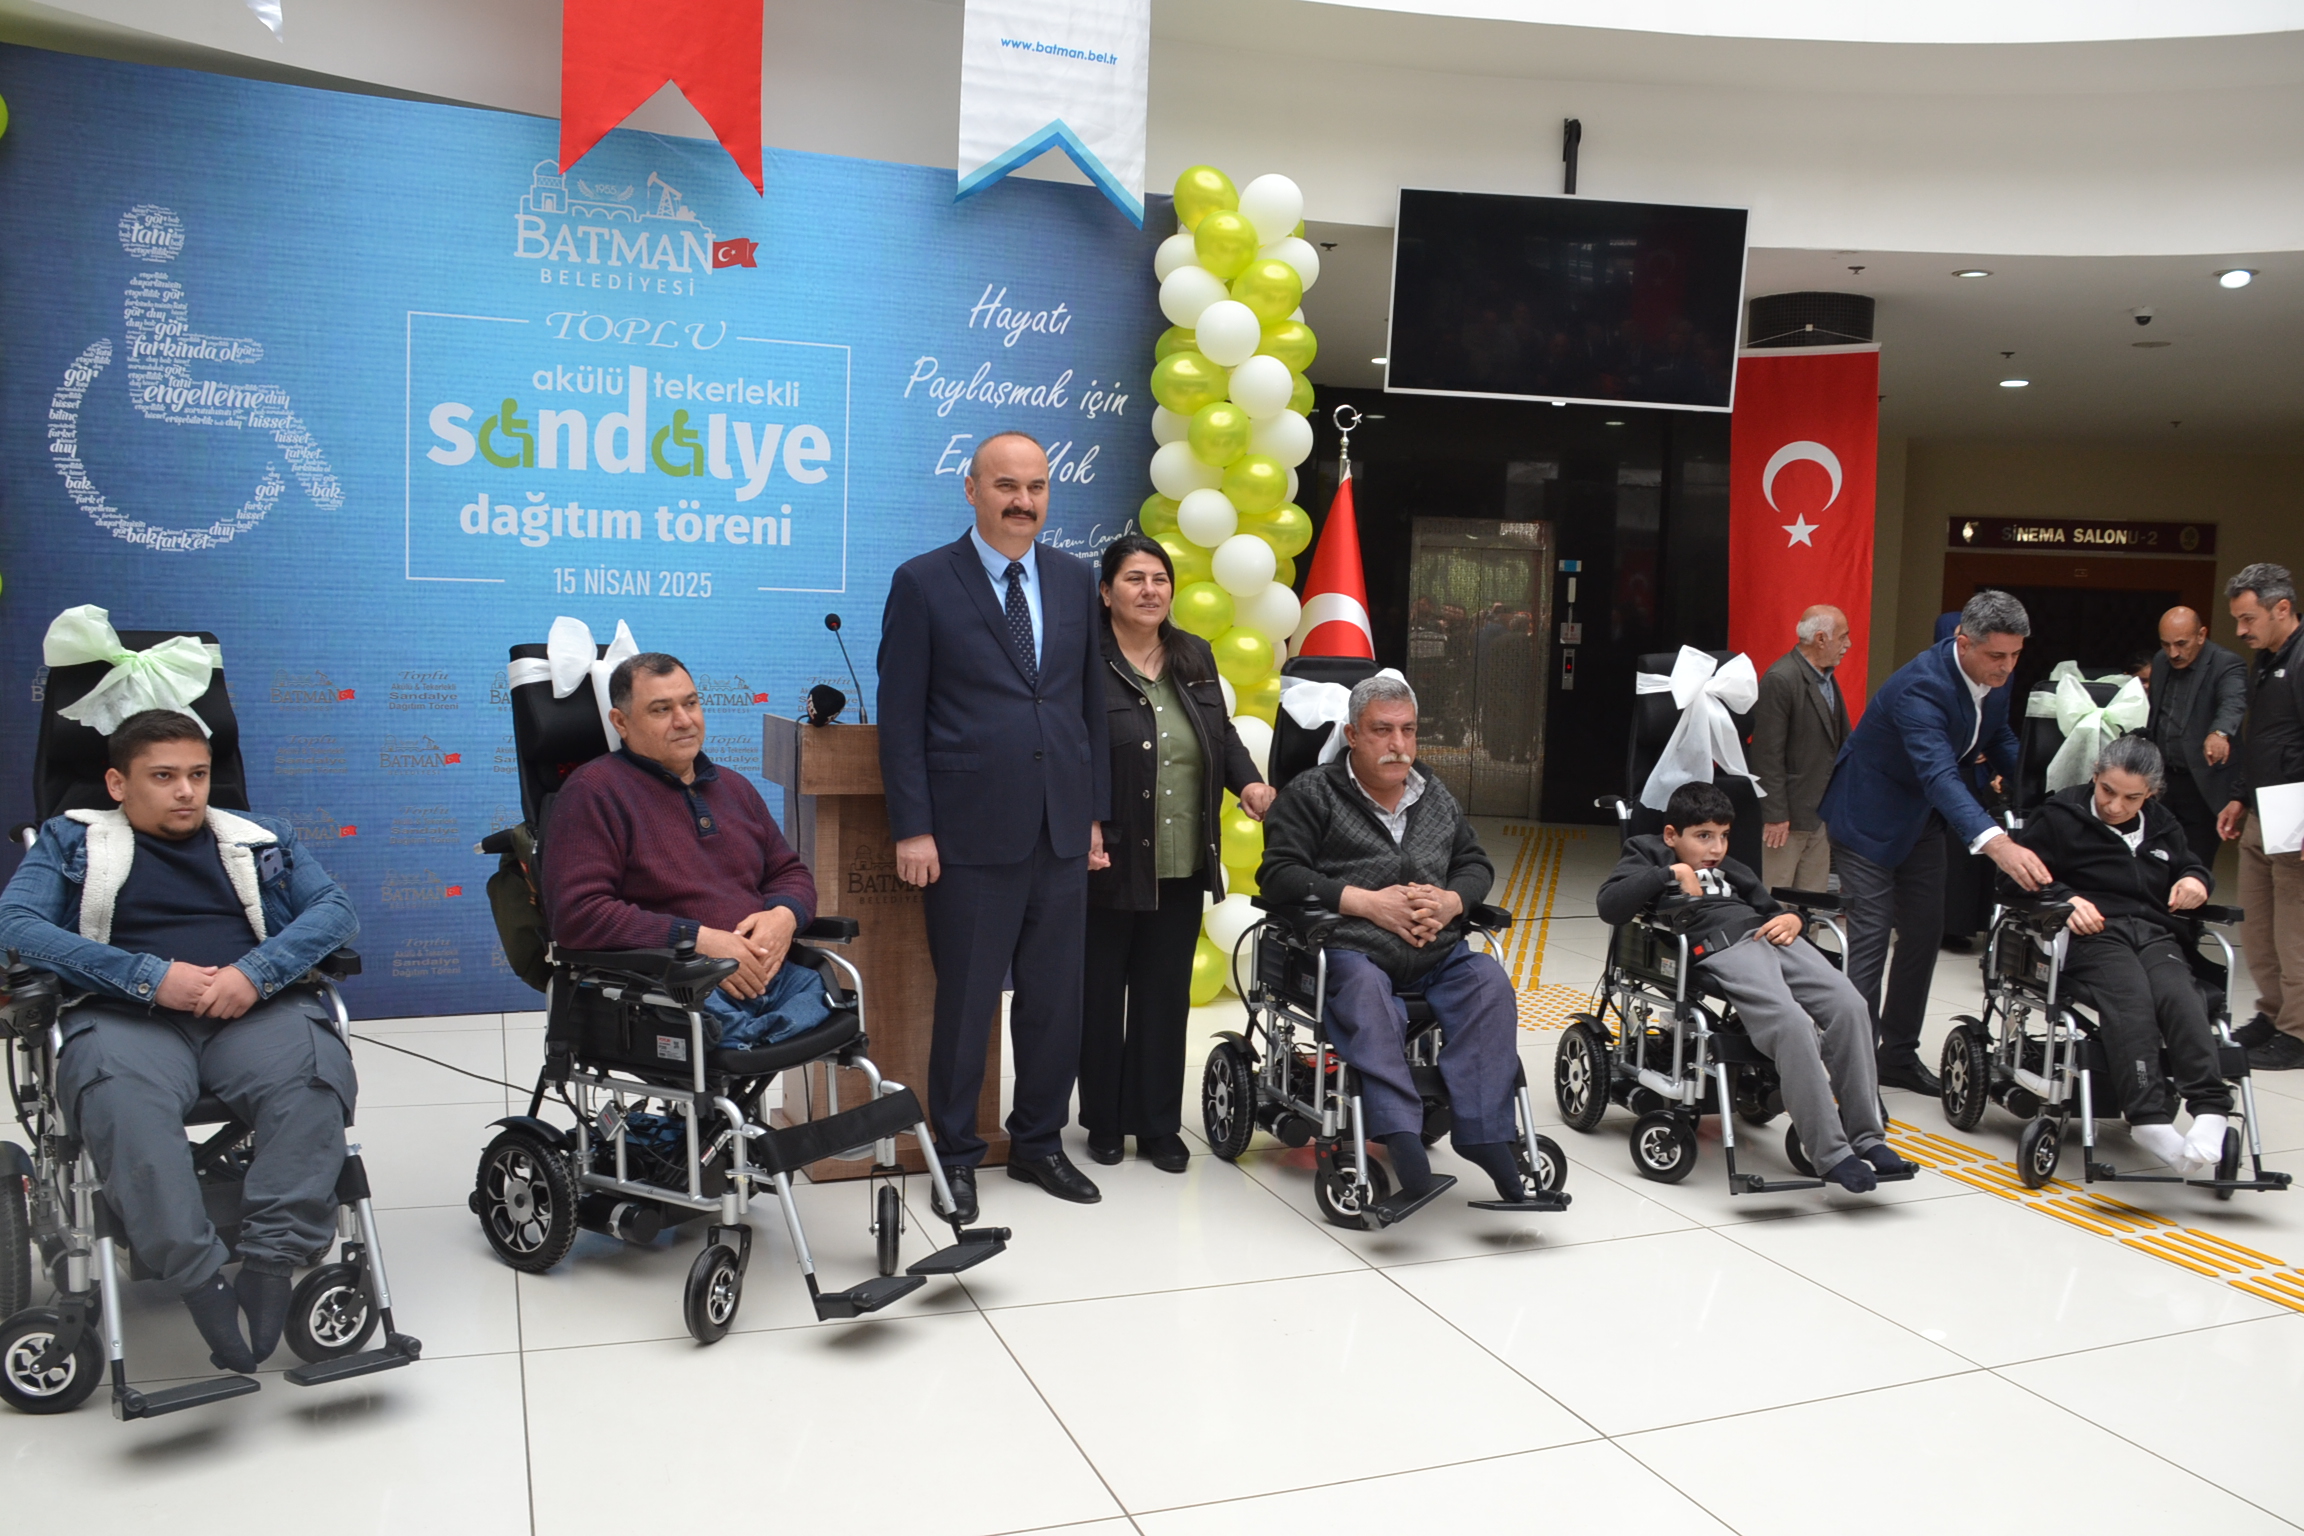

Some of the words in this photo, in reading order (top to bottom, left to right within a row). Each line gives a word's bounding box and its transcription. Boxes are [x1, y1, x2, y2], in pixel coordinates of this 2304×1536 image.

[1000, 38, 1118, 65] www.batman.bel.tr
[594, 183, 617, 196] 1955
[513, 213, 716, 275] BATMAN
[541, 268, 695, 296] BELEDİYESİ
[968, 283, 1072, 348] Hayatı
[154, 319, 189, 341] gör
[545, 310, 727, 350] TOPLU
[132, 334, 217, 360] farkinda
[219, 341, 238, 361] ol
[64, 365, 99, 387] gör
[532, 365, 624, 395] akülü
[653, 371, 800, 407] tekerlekli
[904, 356, 1073, 417] Paylaşmak
[1080, 380, 1129, 419] için
[143, 380, 265, 412] engelleme
[264, 390, 290, 409] duy
[248, 411, 295, 429] hisset
[50, 439, 77, 458] duy
[65, 475, 91, 490] bak
[255, 481, 285, 502] gör
[311, 482, 341, 498] bak
[459, 491, 642, 548] dağıtım
[655, 499, 792, 546] töreni
[126, 527, 157, 544] bak
[209, 521, 235, 541] duy
[2001, 524, 2065, 543] SİNEMA
[553, 568, 576, 594] 15
[584, 563, 651, 596] NİSAN
[659, 571, 712, 598] 2025
[398, 670, 449, 682] Toplu
[270, 688, 340, 704] BATMAN
[389, 692, 458, 701] Sandalye
[698, 691, 756, 706] BATMAN
[706, 735, 751, 745] Toplu
[380, 753, 447, 768] BATMAN
[709, 755, 760, 764] andalye
[297, 824, 342, 841] TMAN
[381, 886, 447, 902] BATMAN
